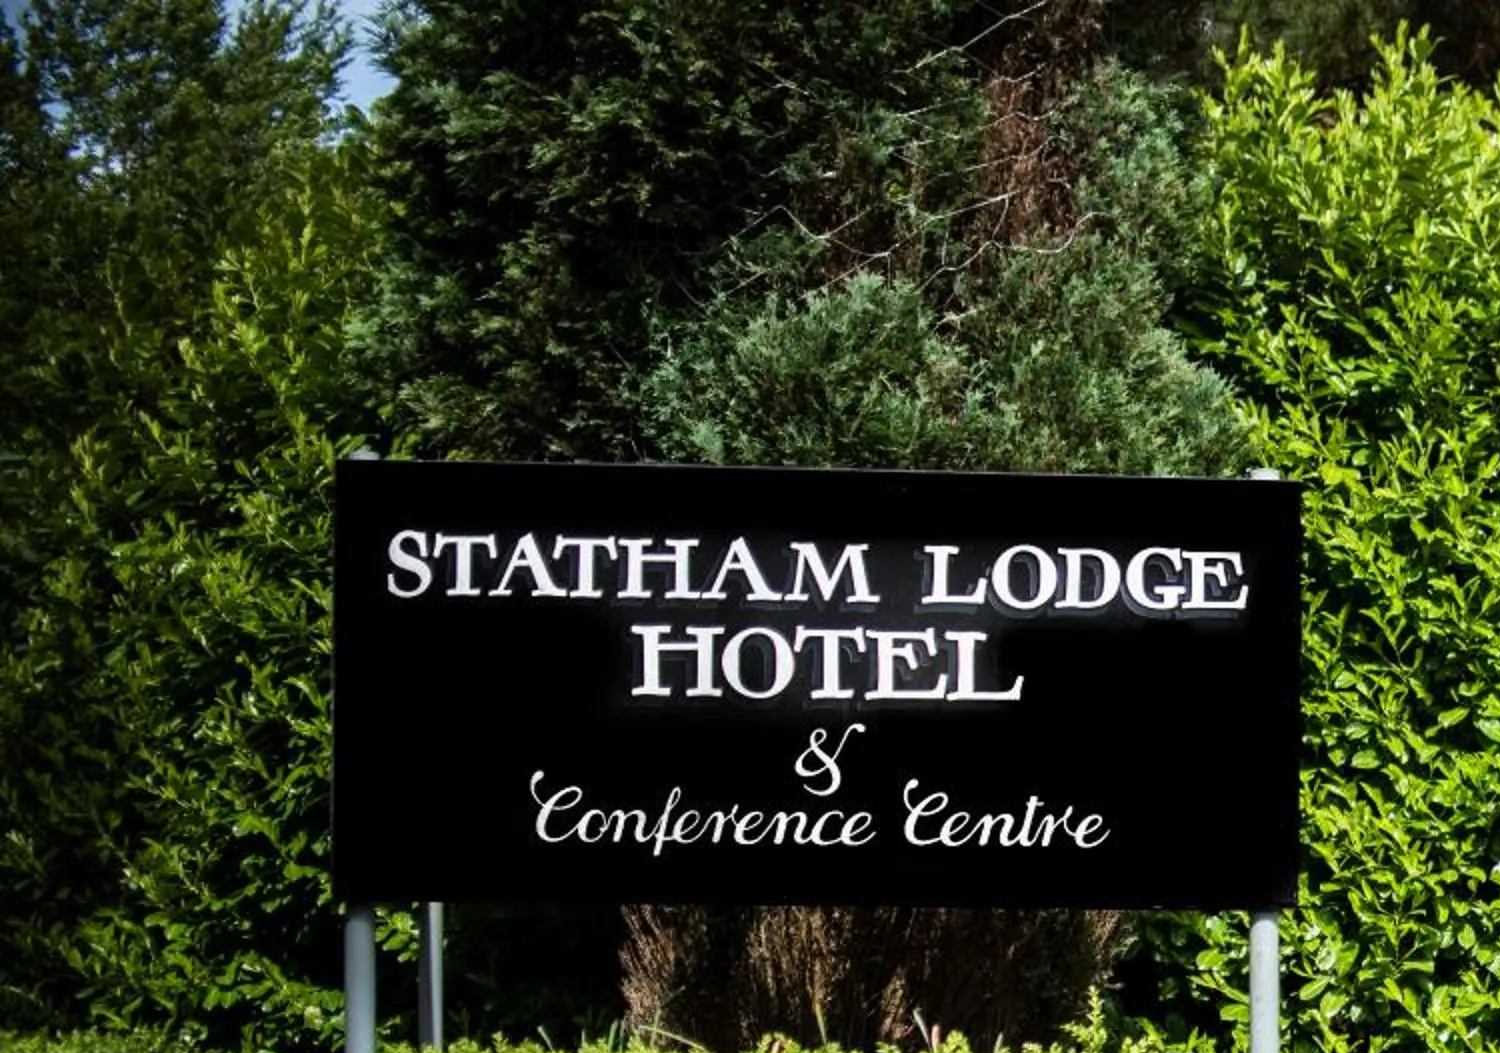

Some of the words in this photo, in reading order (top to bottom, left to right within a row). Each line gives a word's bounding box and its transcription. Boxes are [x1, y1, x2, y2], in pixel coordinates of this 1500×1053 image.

[386, 529, 881, 603] STATHAM
[920, 544, 1250, 611] LODGE
[630, 624, 1026, 702] HOTEL
[794, 722, 867, 797] &
[529, 769, 877, 857] Conference
[902, 777, 1112, 849] Centre
